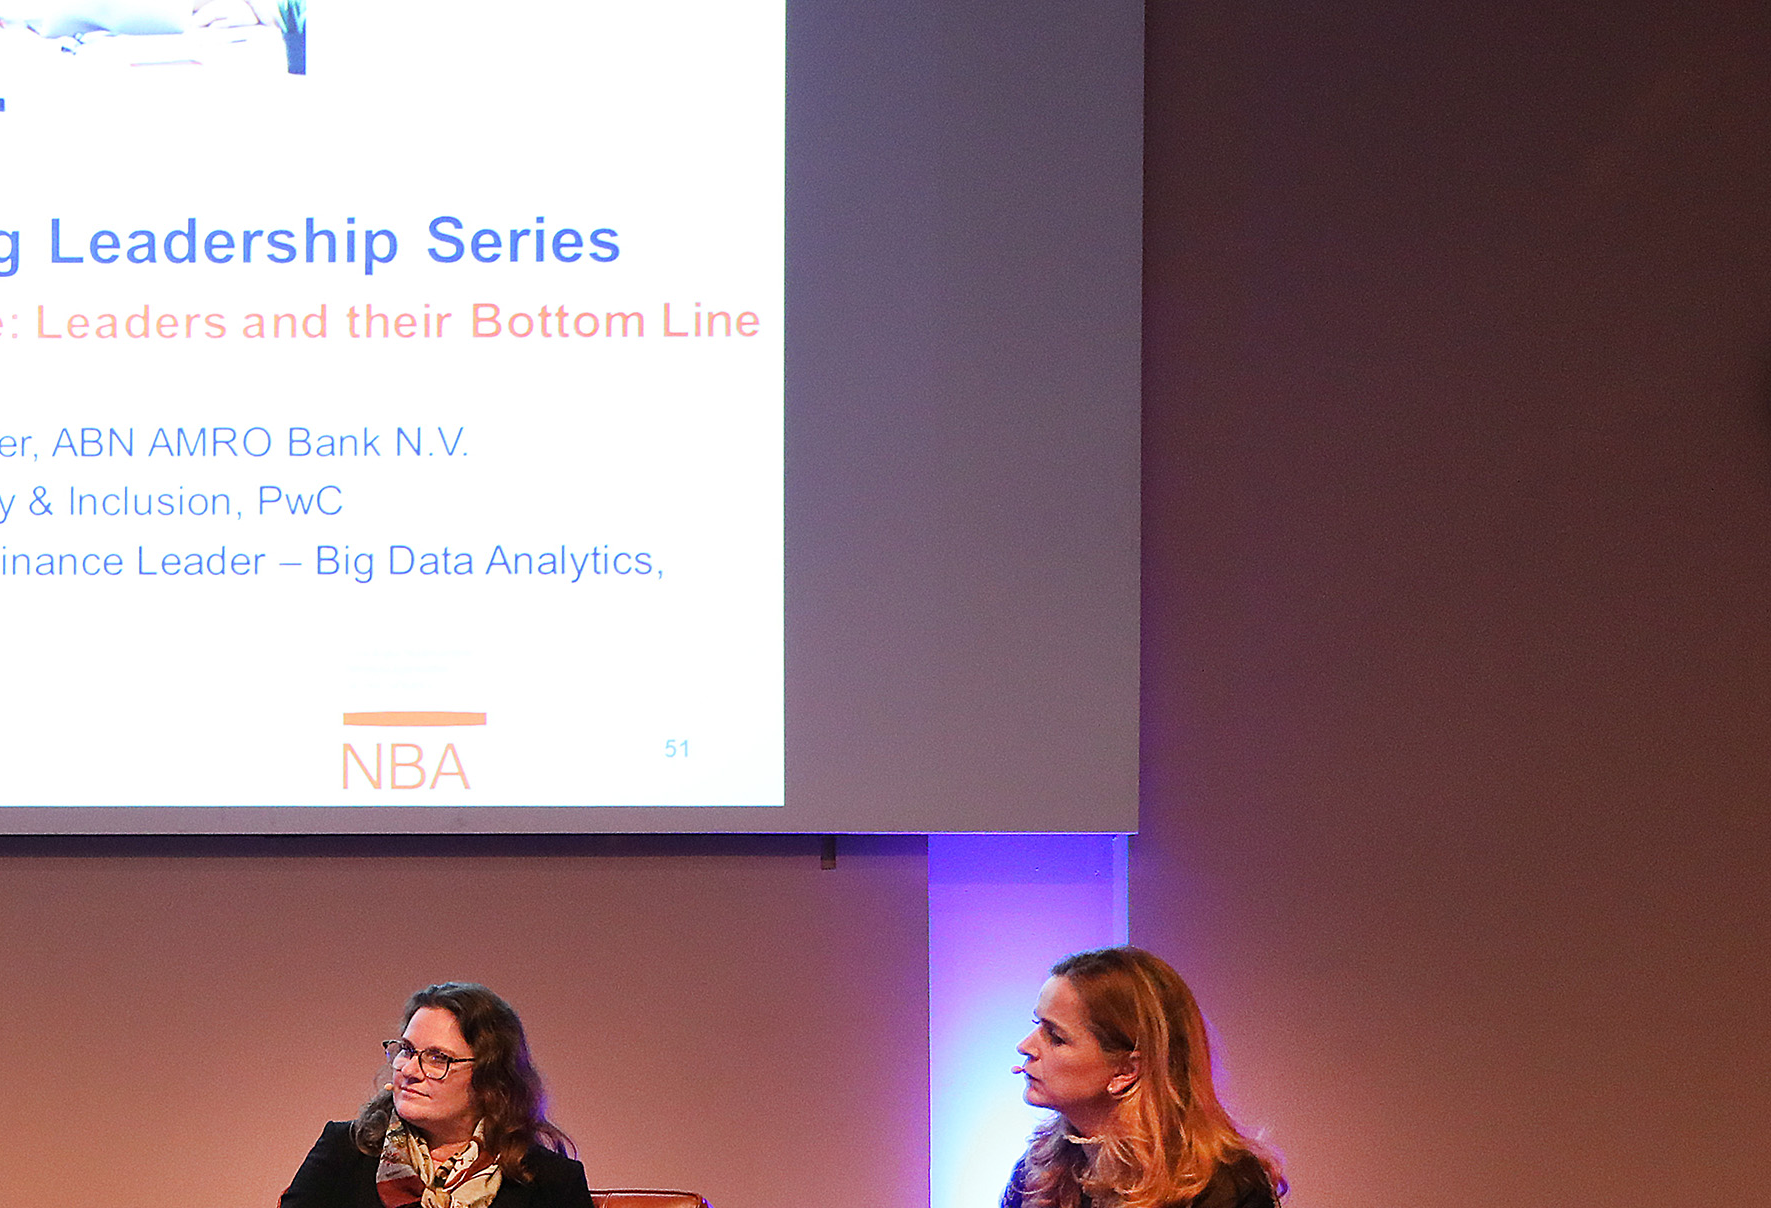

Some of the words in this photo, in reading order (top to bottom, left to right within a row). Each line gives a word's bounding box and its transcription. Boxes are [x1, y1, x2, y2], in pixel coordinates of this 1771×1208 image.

[51, 216, 399, 277] Leadership
[427, 215, 621, 264] Series
[37, 303, 226, 340] Leaders
[242, 303, 328, 339] and
[345, 303, 453, 339] their
[471, 302, 645, 339] Bottom
[662, 301, 761, 338] Line
[51, 426, 134, 458] ABN
[147, 425, 273, 458] AMRO
[288, 426, 382, 458] Bank
[395, 425, 468, 457] N.V.
[70, 485, 242, 521] Inclusion,
[259, 484, 344, 516] PwC
[138, 544, 267, 576] Leader
[316, 544, 375, 584] Big
[389, 544, 475, 576] Data
[484, 543, 664, 584] Analytics,
[342, 742, 471, 790] NBA
[665, 738, 689, 758] 51
